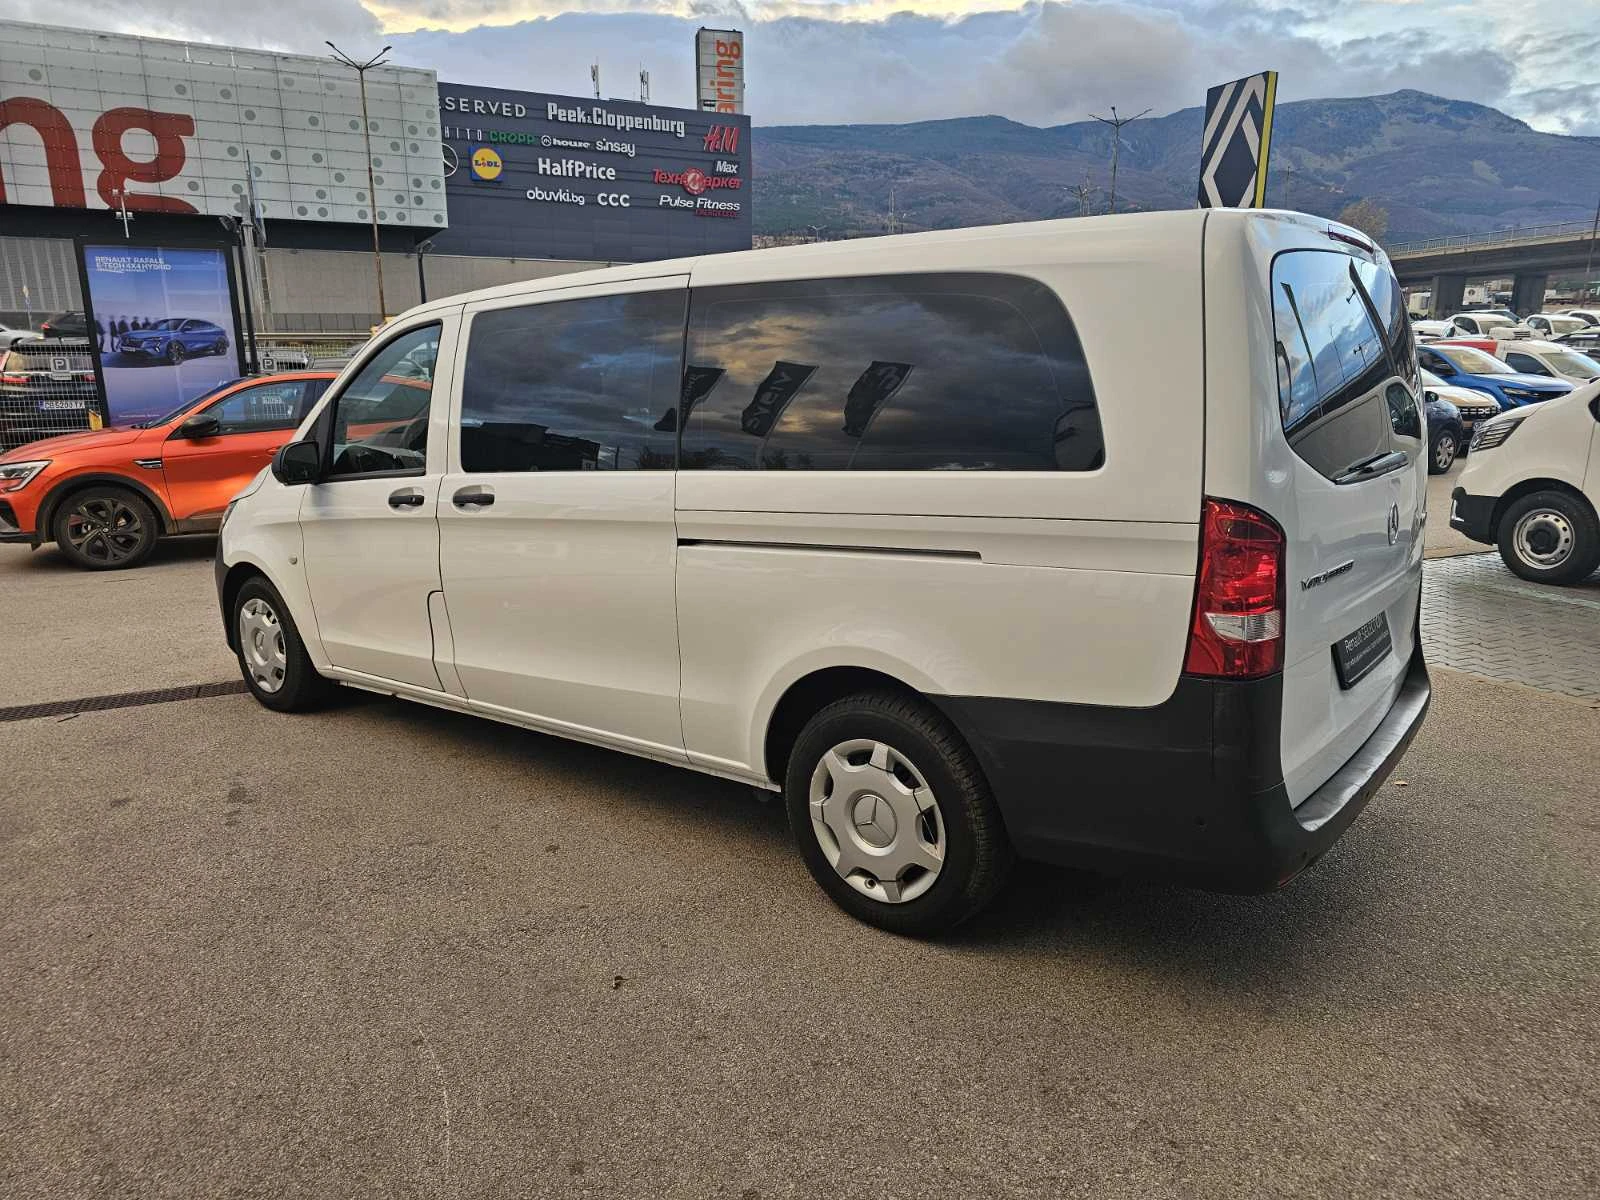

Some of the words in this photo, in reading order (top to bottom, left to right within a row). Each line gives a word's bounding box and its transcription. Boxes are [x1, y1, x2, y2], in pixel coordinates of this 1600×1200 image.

[439, 96, 527, 118] SERVED
[489, 131, 536, 145] CROPP
[596, 138, 636, 157] sinsay
[703, 124, 739, 154] H&M
[538, 157, 616, 180] HalfPrice
[716, 160, 738, 173] Max
[526, 186, 586, 206] obuvki.bg
[659, 195, 694, 208] Pulse
[697, 198, 740, 212] Fitness
[95, 256, 131, 264] RENAULT
